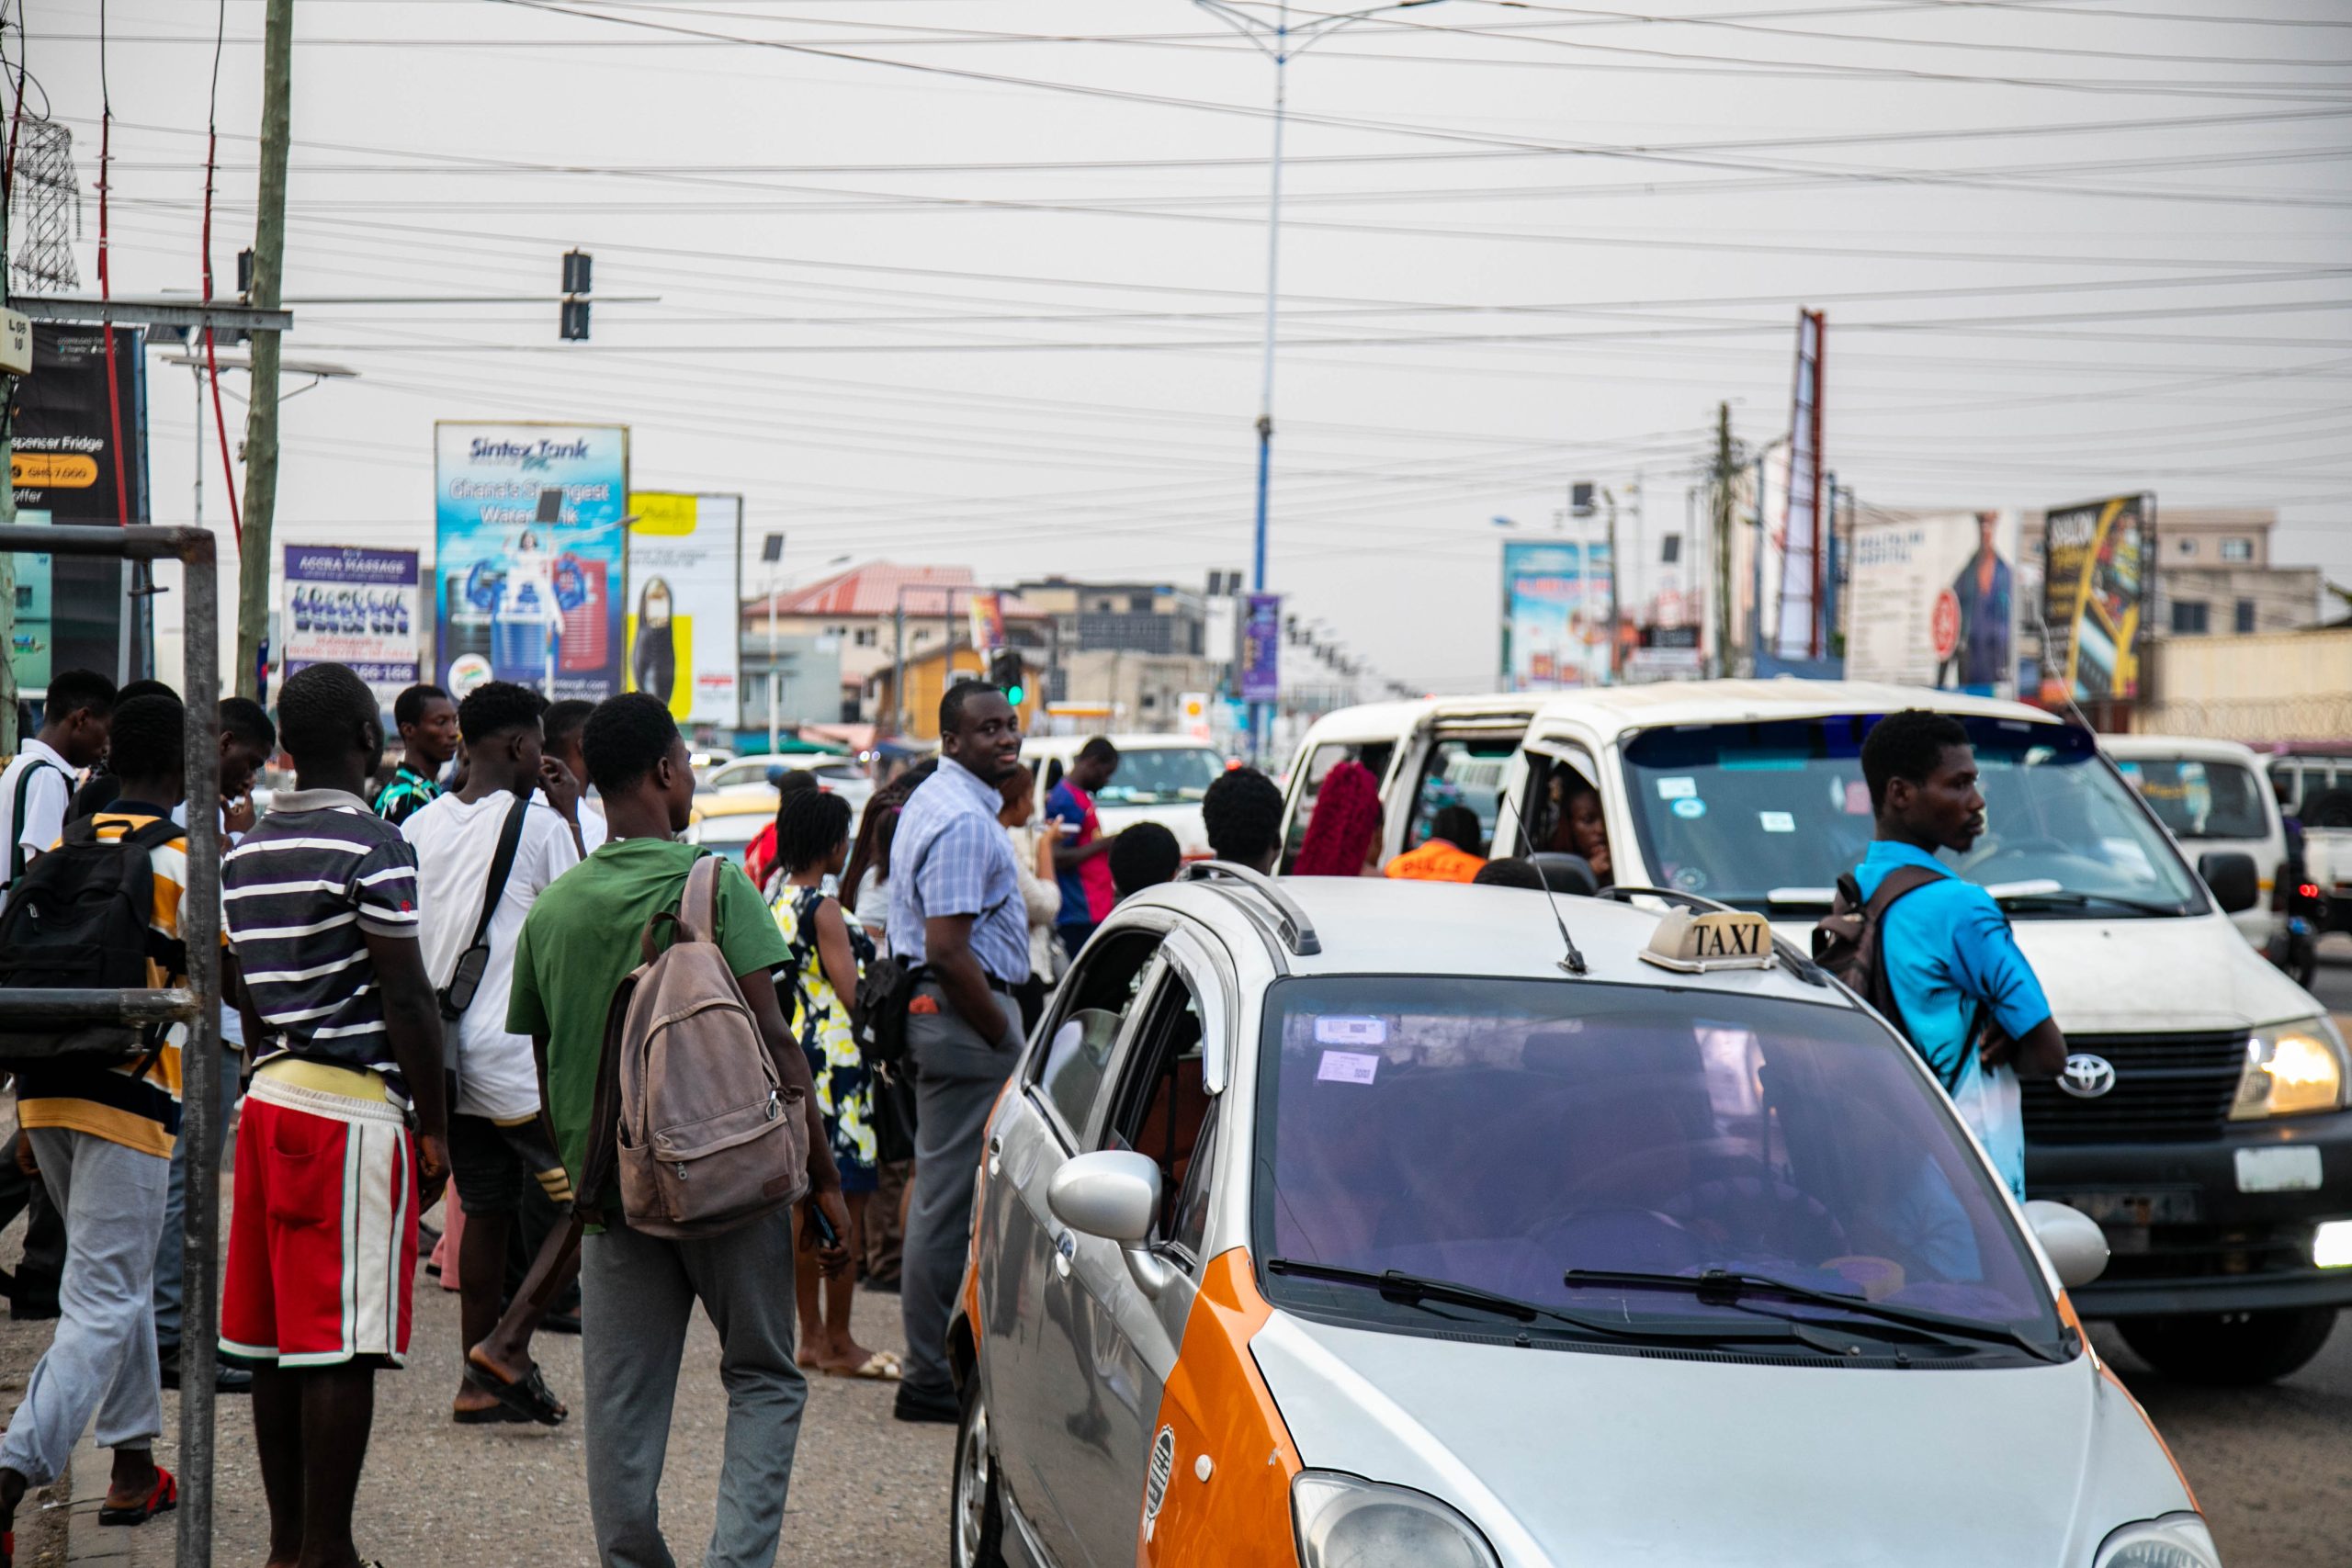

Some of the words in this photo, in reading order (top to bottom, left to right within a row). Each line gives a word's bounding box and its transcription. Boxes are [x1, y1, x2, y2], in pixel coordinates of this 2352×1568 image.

[62, 435, 104, 452] Fridge
[537, 439, 590, 457] Tank
[13, 489, 42, 502] offer
[449, 479, 519, 500] Ghana's
[523, 479, 610, 503] Stngest
[481, 506, 535, 525] Water
[300, 557, 344, 572] ACCRA
[345, 558, 405, 574] MASSAGE
[1693, 922, 1762, 956] TAXI
